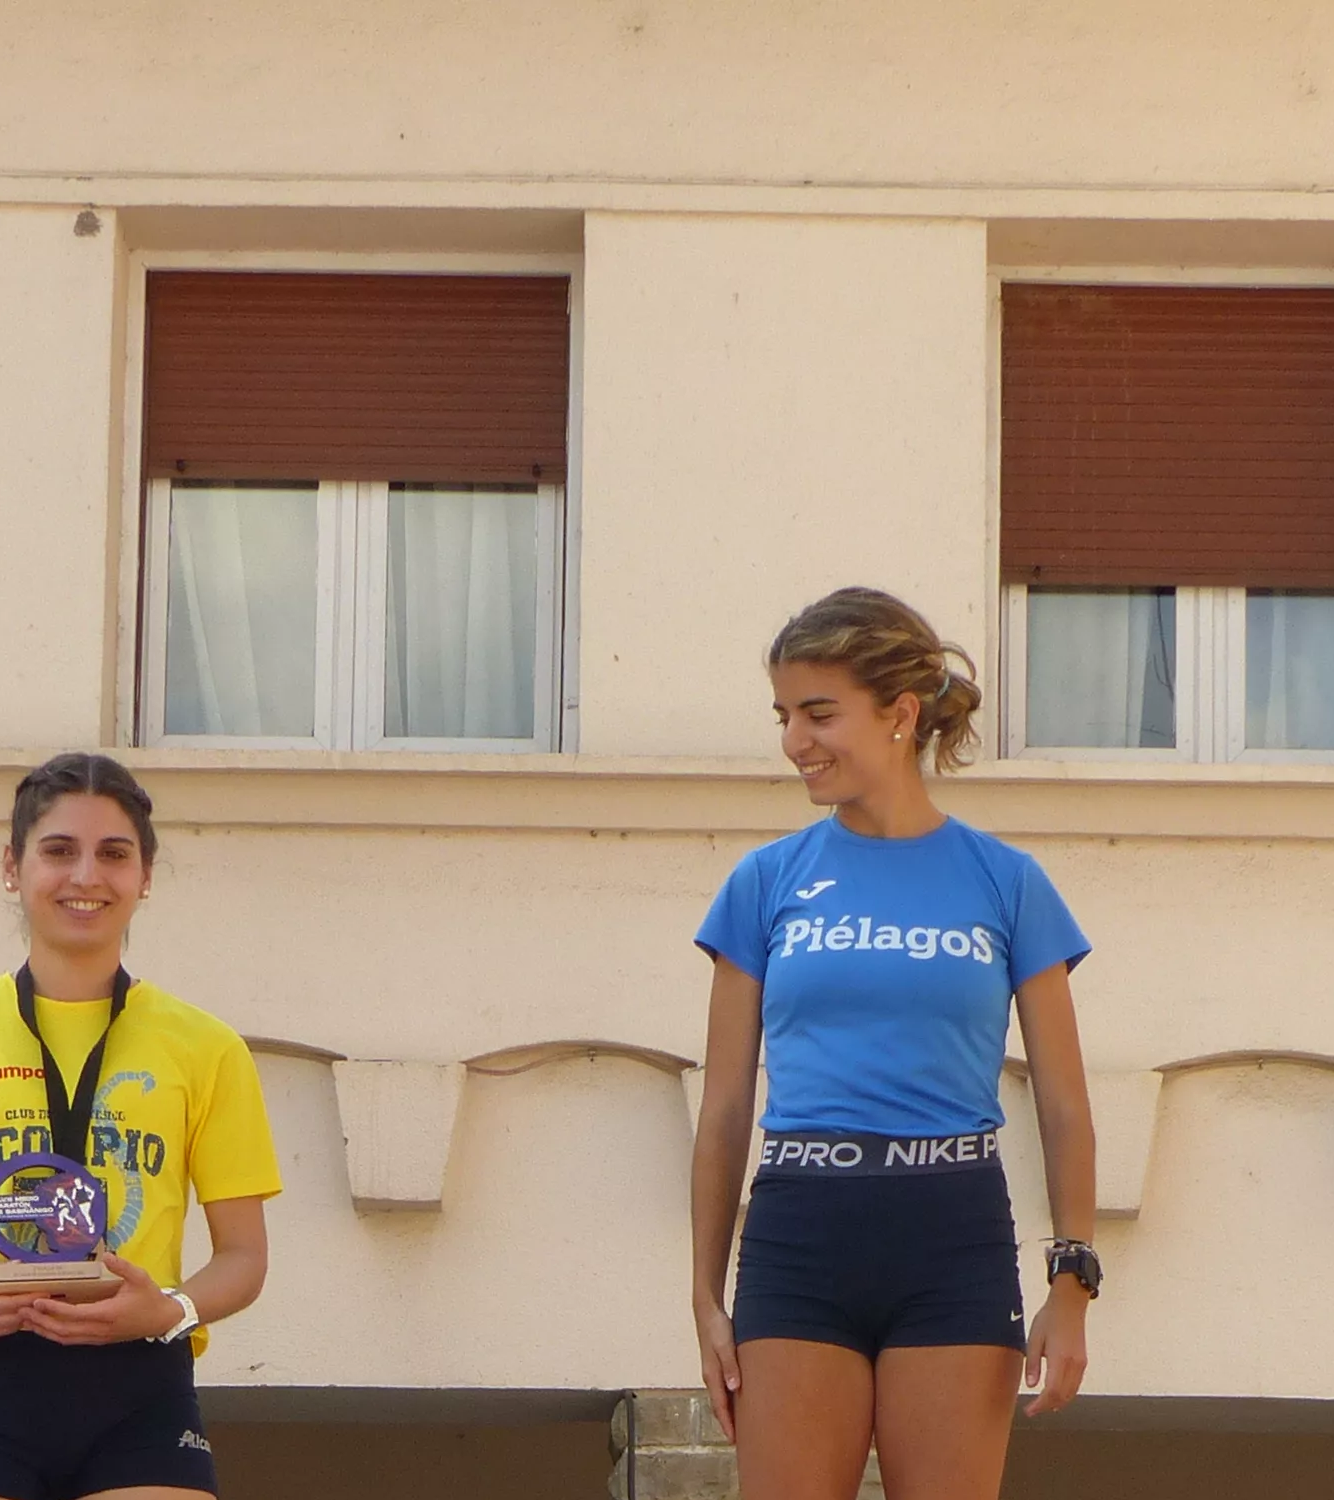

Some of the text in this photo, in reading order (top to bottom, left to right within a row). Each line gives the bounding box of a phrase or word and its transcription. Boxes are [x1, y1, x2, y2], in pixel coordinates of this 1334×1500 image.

[5, 1109, 35, 1120] CLUB
[776, 1142, 863, 1168] PRO
[884, 1135, 977, 1167] NIKE
